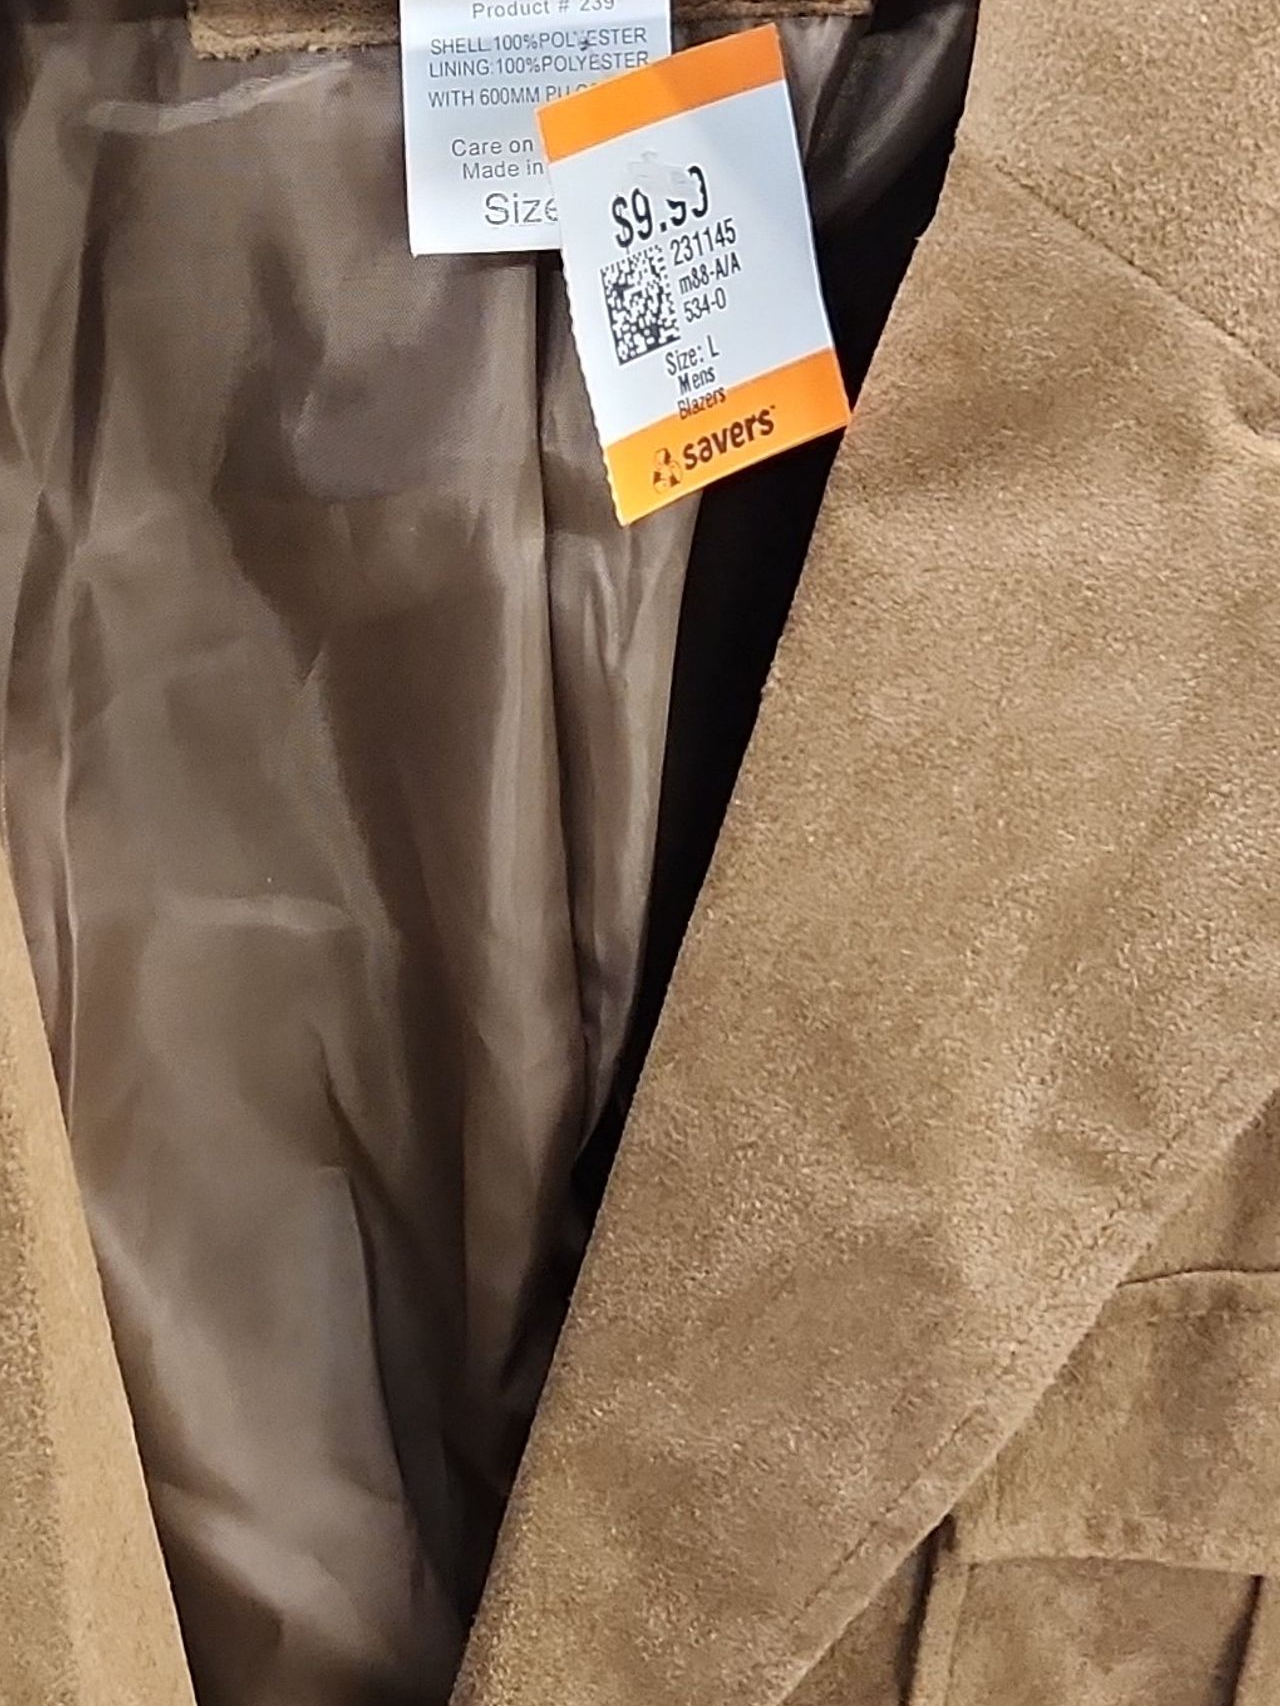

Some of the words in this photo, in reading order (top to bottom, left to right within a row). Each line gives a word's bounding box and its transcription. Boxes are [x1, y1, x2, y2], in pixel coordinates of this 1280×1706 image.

[472, 0, 550, 19] Product
[428, 89, 475, 108] WITH
[480, 86, 540, 105] 600MM
[451, 139, 503, 157] Care
[509, 139, 534, 153] on
[462, 161, 520, 179] Made
[526, 159, 544, 175] in
[670, 218, 736, 266] 231145
[665, 345, 705, 377] Size:
[707, 335, 719, 357] L
[678, 366, 716, 395] Mens
[677, 386, 726, 420] Blazers
[683, 408, 775, 470] savers
